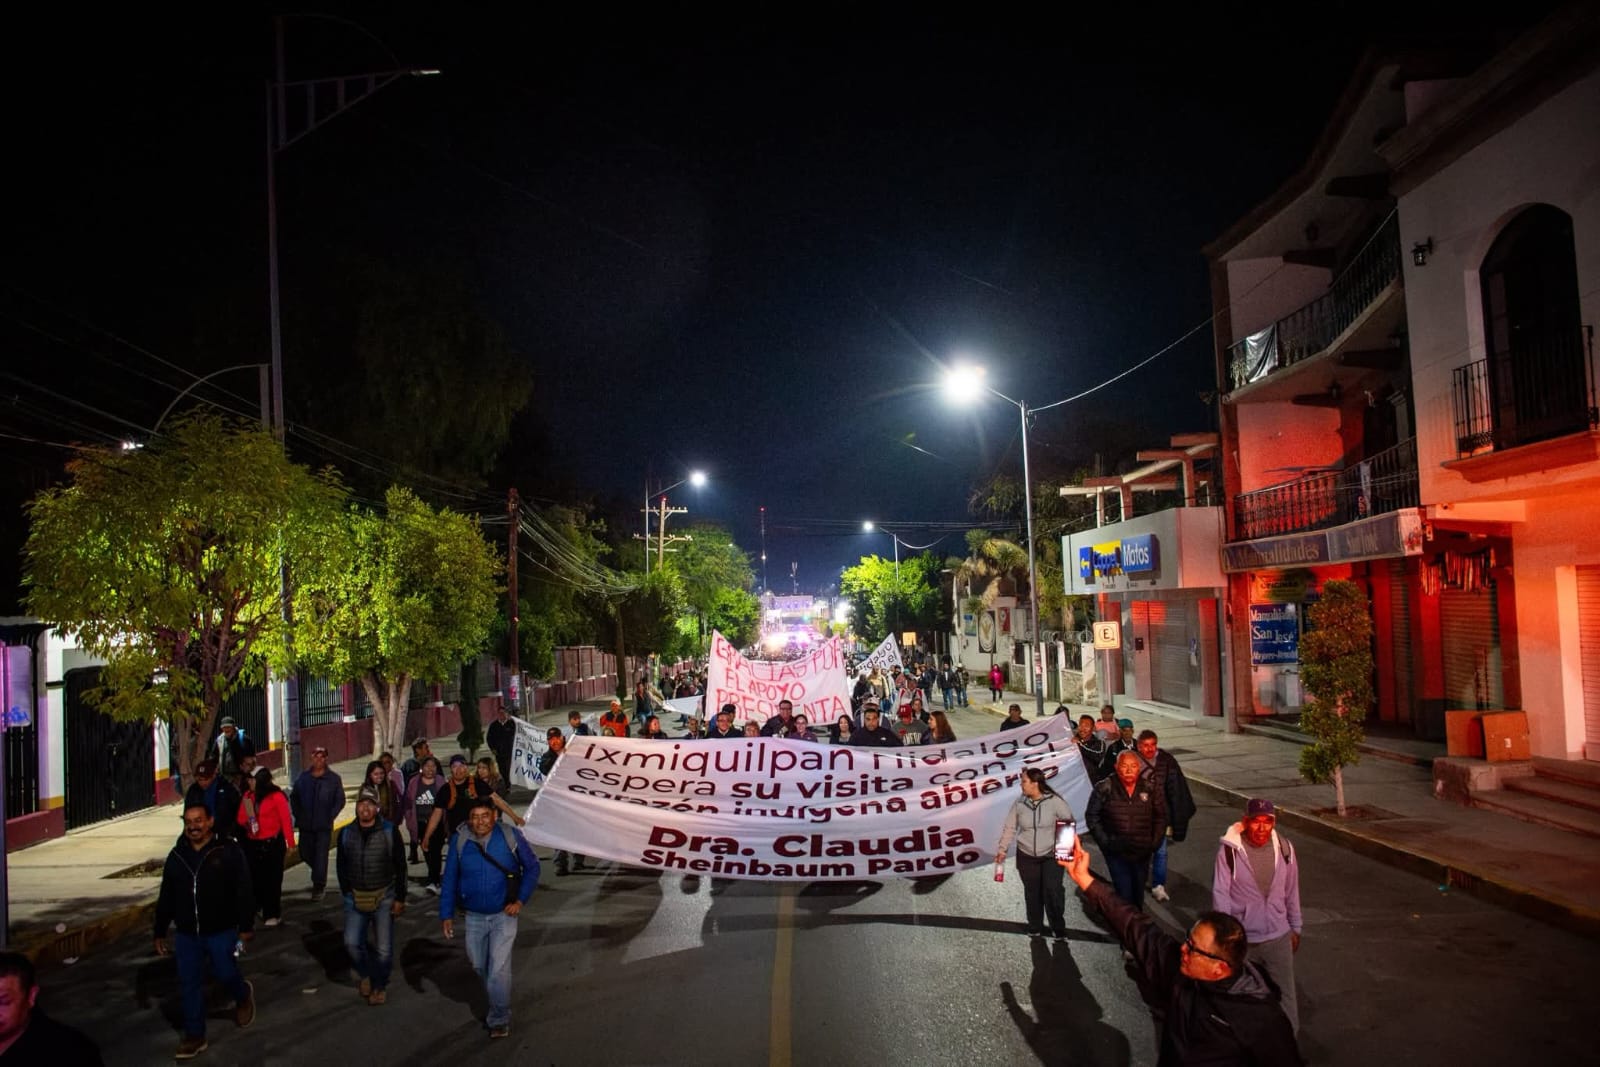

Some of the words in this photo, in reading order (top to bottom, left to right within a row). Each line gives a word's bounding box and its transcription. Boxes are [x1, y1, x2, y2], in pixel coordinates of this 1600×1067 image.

[1123, 543, 1150, 567] Motos
[1103, 628, 1109, 640] E
[1253, 626, 1273, 640] San
[716, 637, 807, 682] GRACIAS
[725, 667, 745, 693] EL
[748, 681, 806, 703] APOYO
[716, 688, 847, 724] PRESINTA
[576, 767, 716, 798] espera
[730, 781, 782, 800] su
[796, 773, 914, 799] visita
[929, 761, 1007, 785] con
[921, 765, 1060, 810] abiero
[648, 825, 756, 857] Dra.
[772, 825, 975, 858] Claudia
[640, 848, 855, 877] Sheinbaum
[867, 849, 980, 876] Pardo
